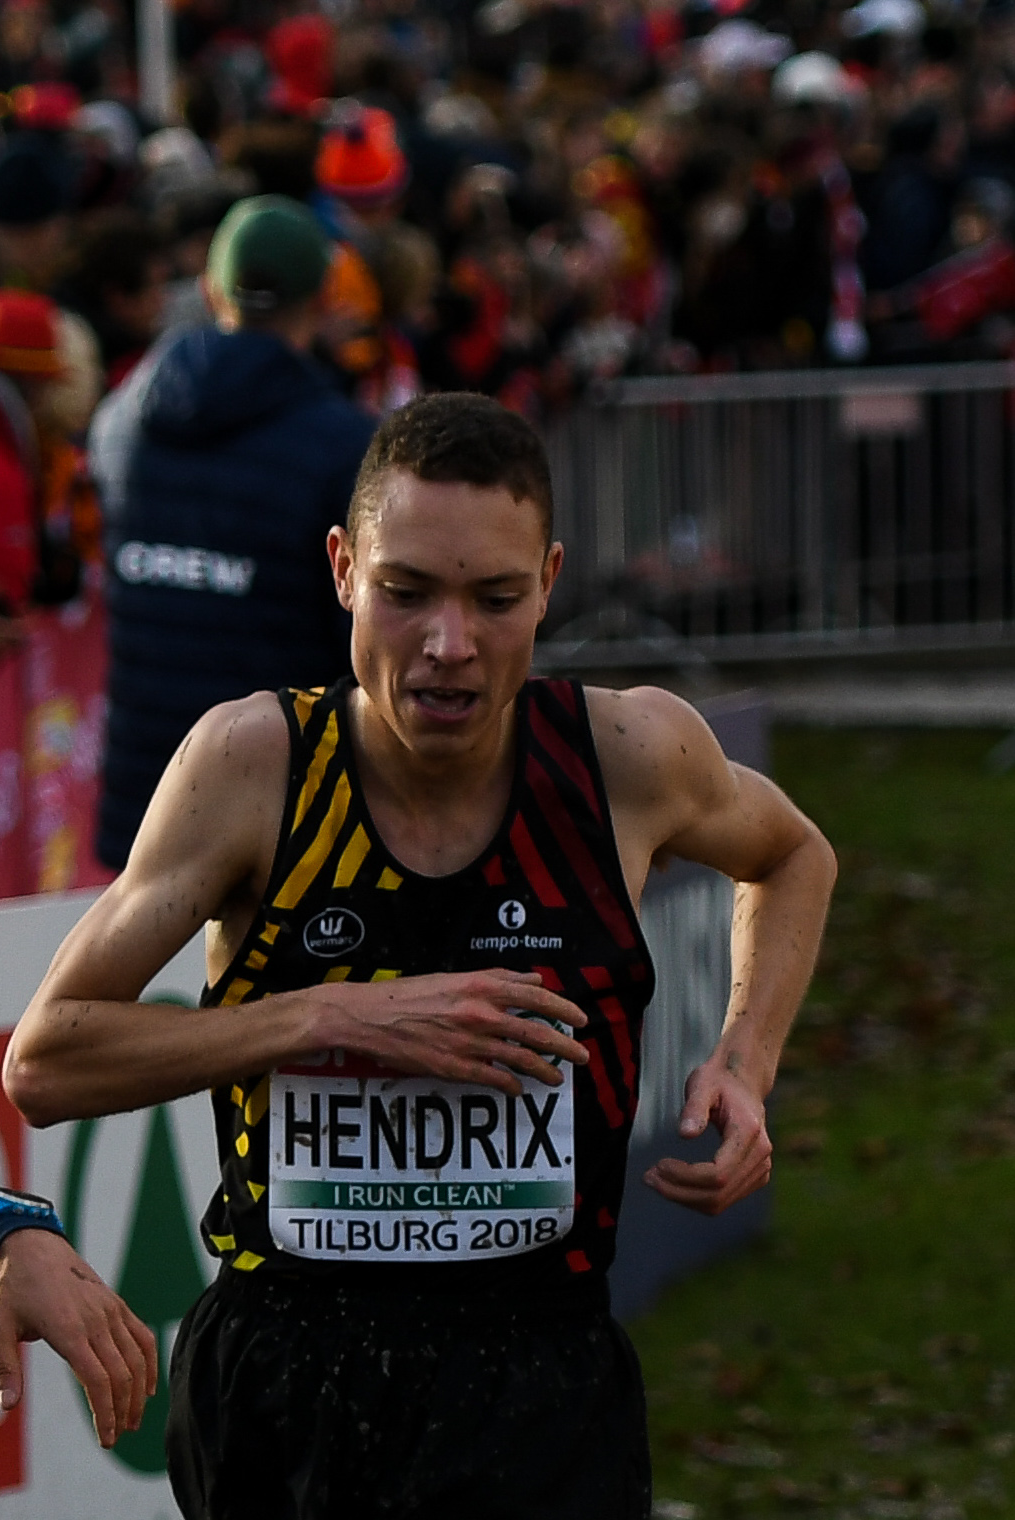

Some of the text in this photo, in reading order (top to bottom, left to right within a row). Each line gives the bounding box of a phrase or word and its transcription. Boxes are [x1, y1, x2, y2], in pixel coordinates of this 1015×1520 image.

[118, 541, 254, 595] CREW
[470, 934, 563, 952] tempo-team
[334, 1185, 340, 1206] I
[349, 1185, 405, 1206] RUN
[288, 1216, 559, 1252] TILBURG 2018
